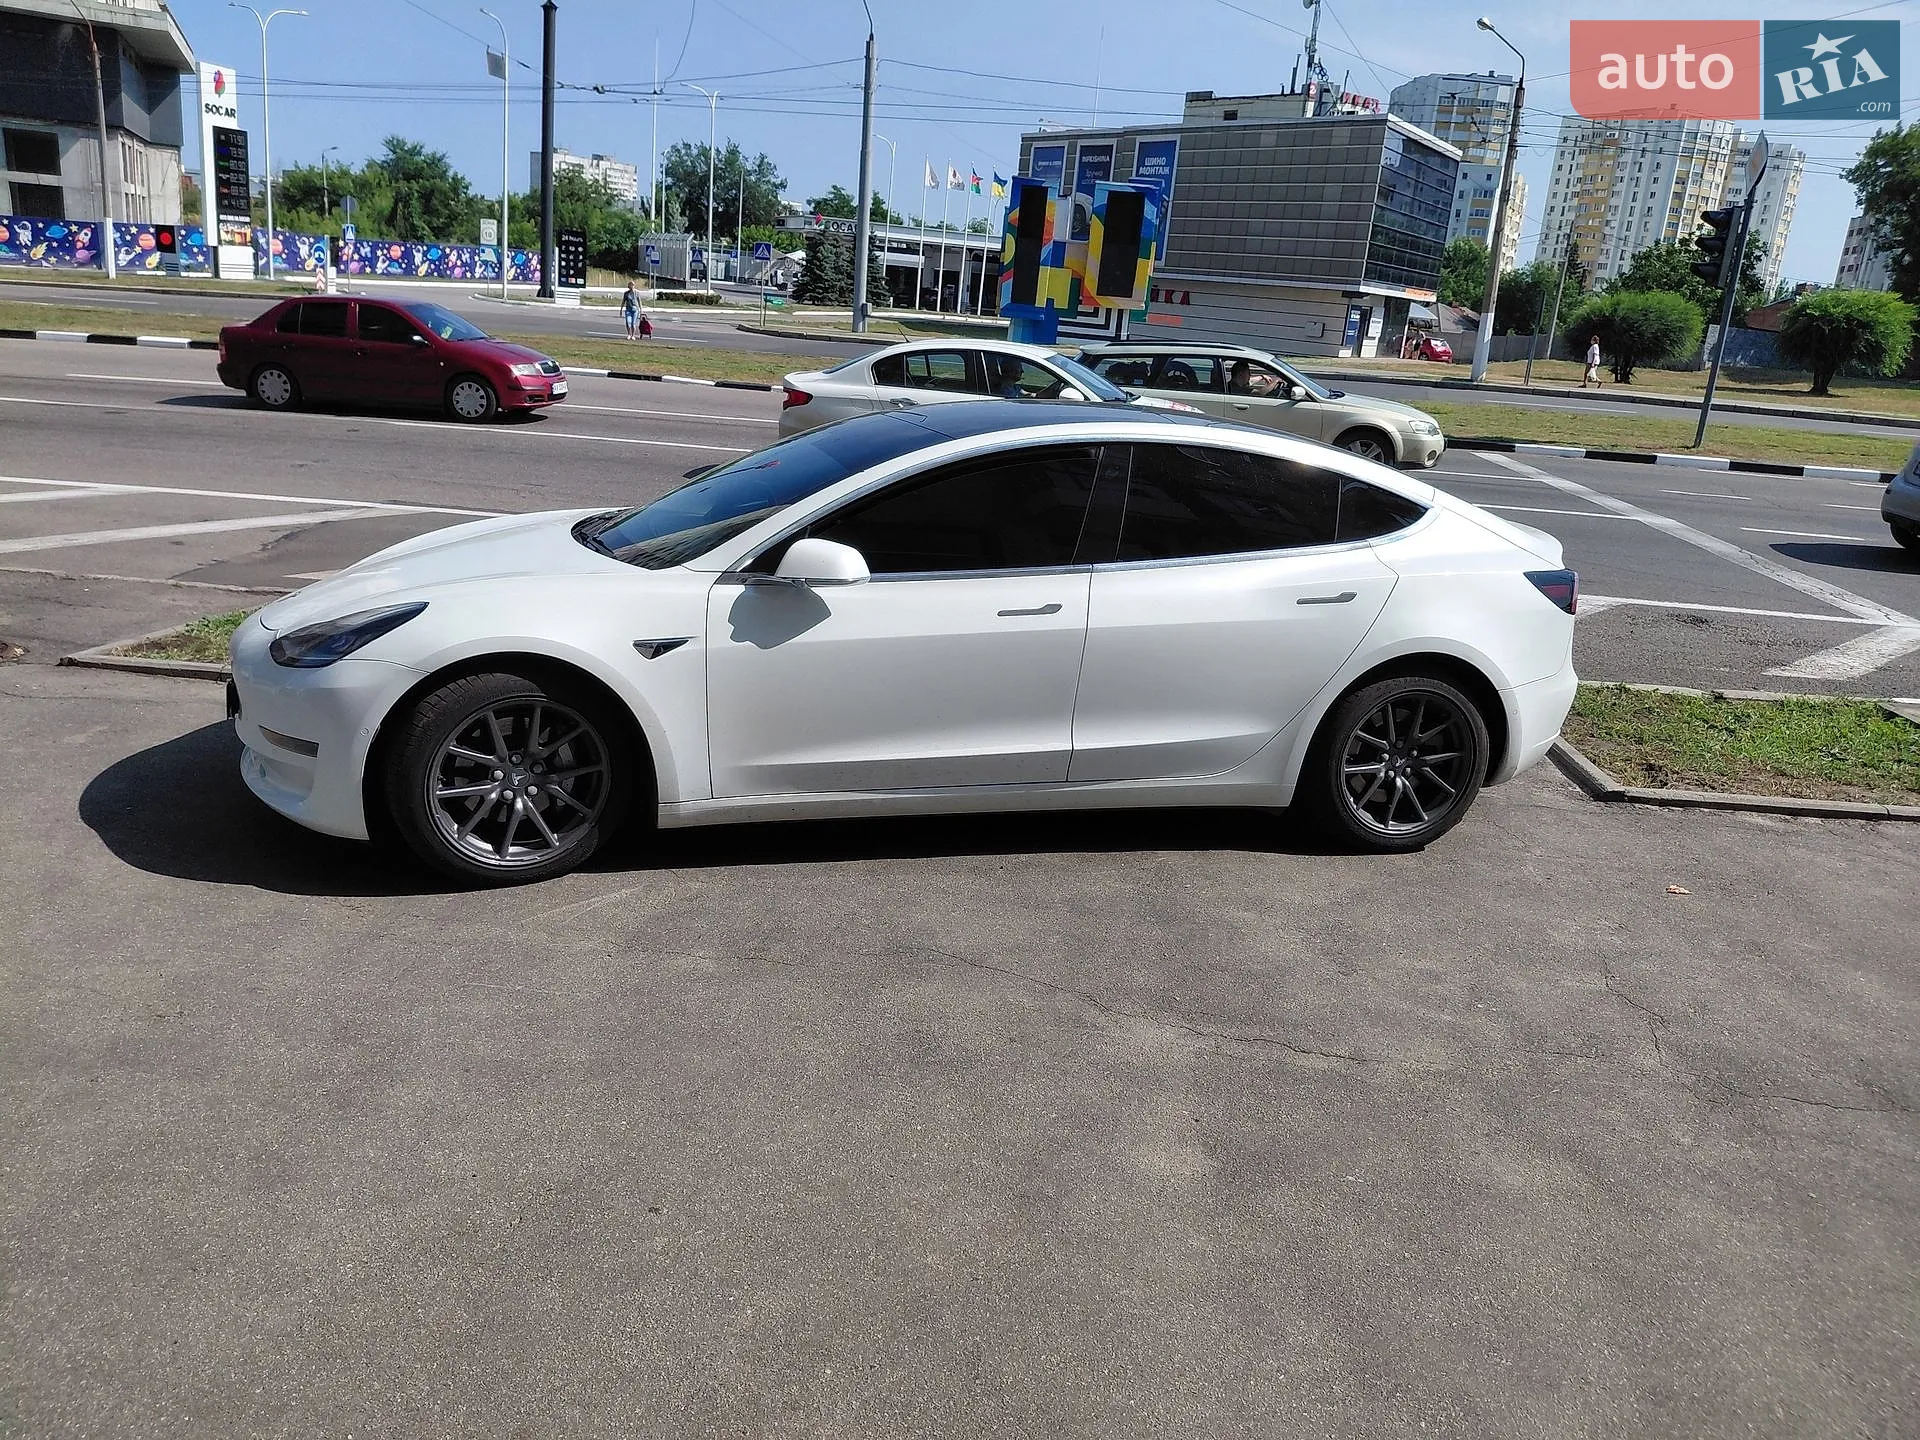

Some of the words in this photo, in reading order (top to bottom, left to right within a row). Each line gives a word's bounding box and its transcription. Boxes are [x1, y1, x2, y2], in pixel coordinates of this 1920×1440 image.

[205, 103, 236, 119] SOCAR
[1144, 157, 1167, 166] ШИНО
[1138, 166, 1170, 175] МОНТАЖ
